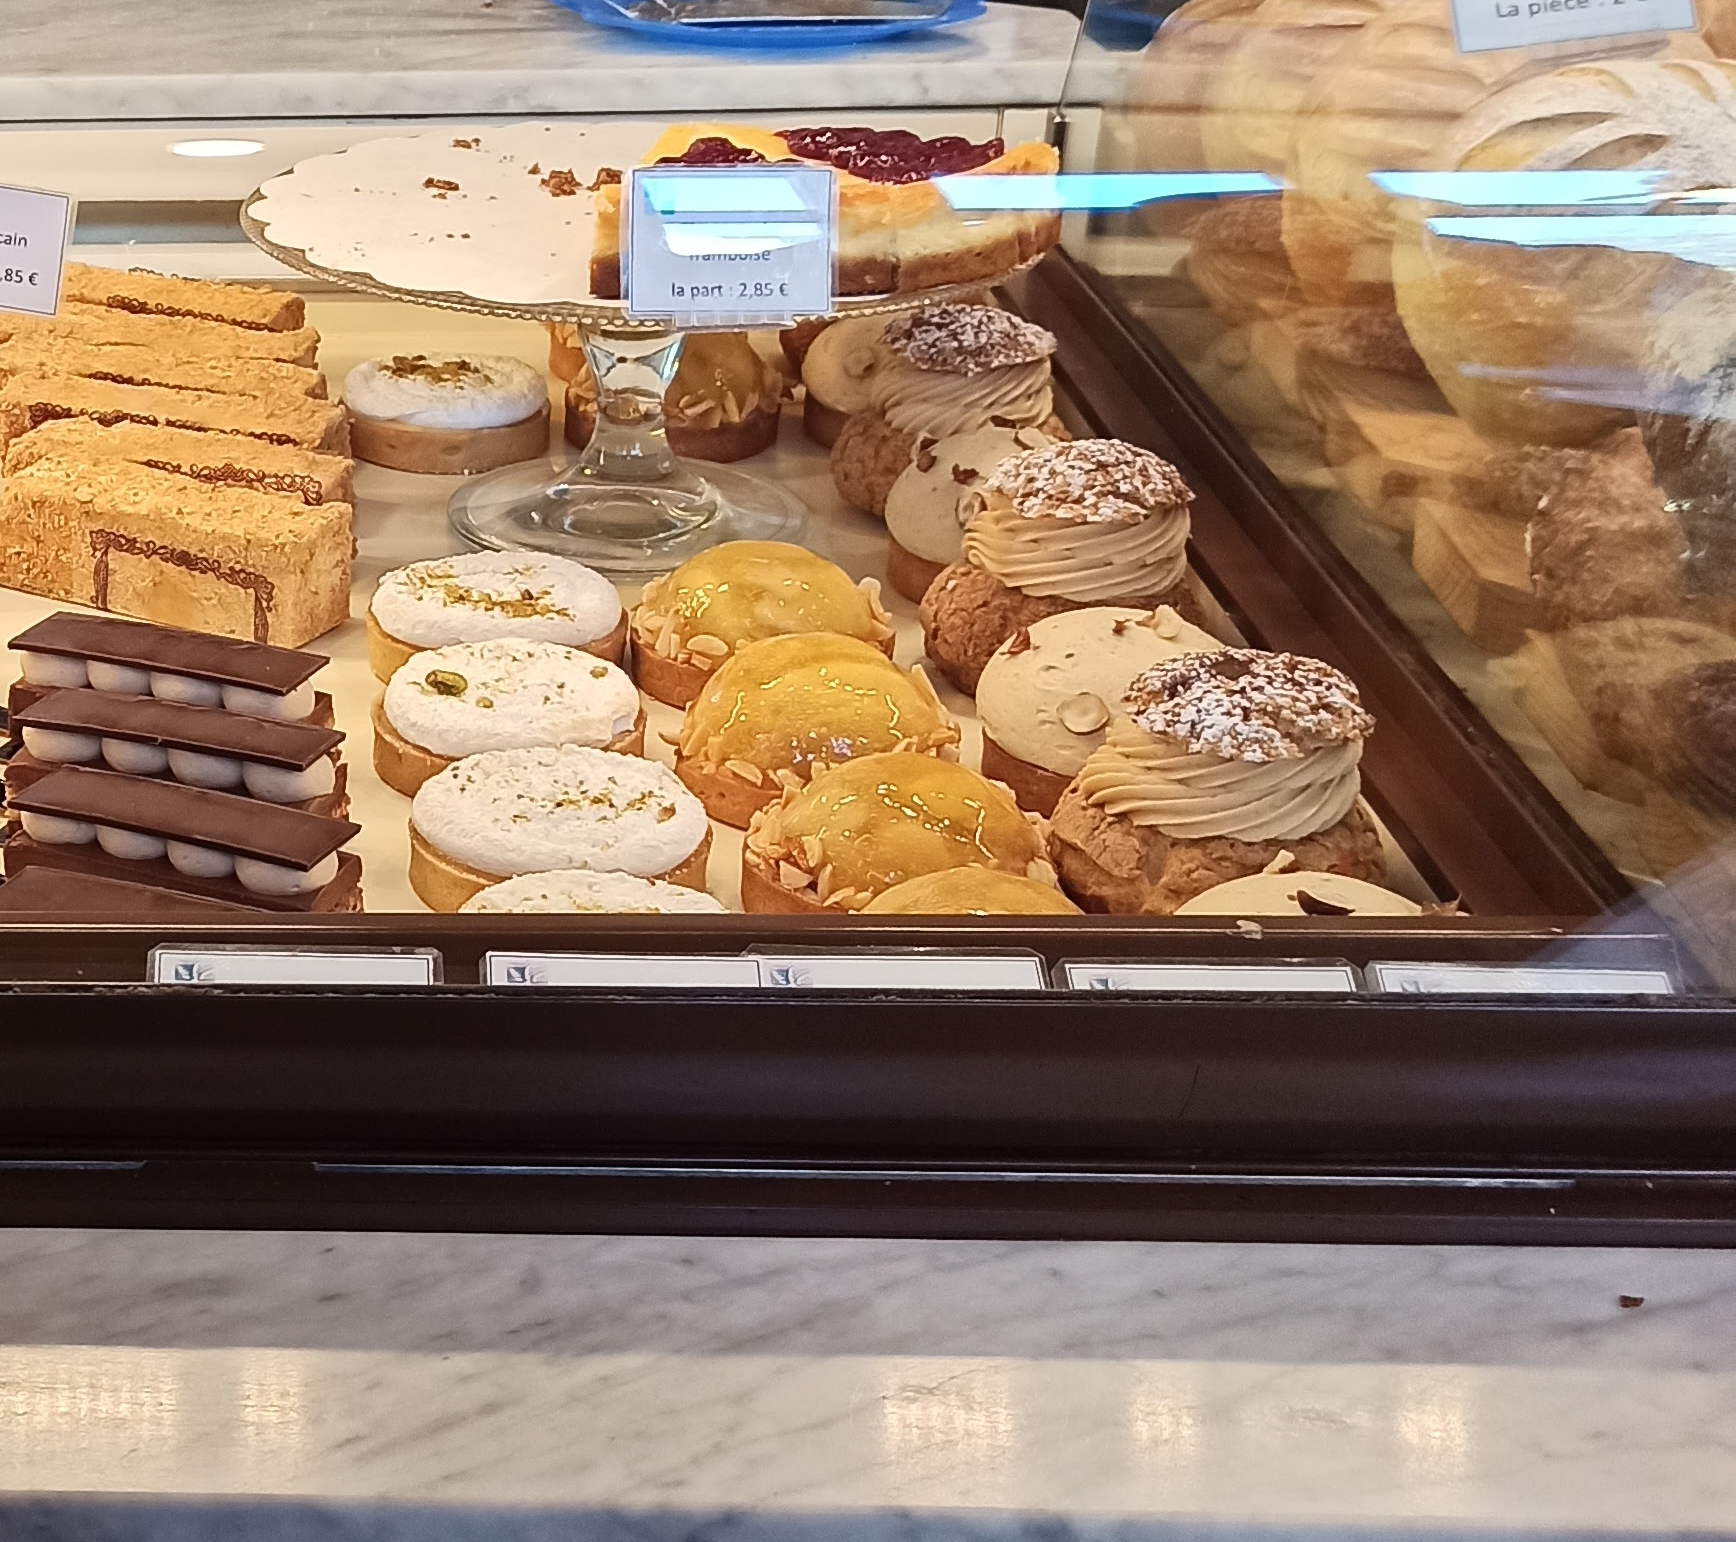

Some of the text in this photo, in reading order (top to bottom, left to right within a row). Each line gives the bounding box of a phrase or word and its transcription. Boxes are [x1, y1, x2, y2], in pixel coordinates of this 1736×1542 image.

[1496, 1, 1520, 18] La
[28, 271, 39, 286] €
[671, 282, 685, 297] la
[690, 284, 723, 300] part
[738, 281, 774, 299] 2,85
[779, 282, 789, 297] €
